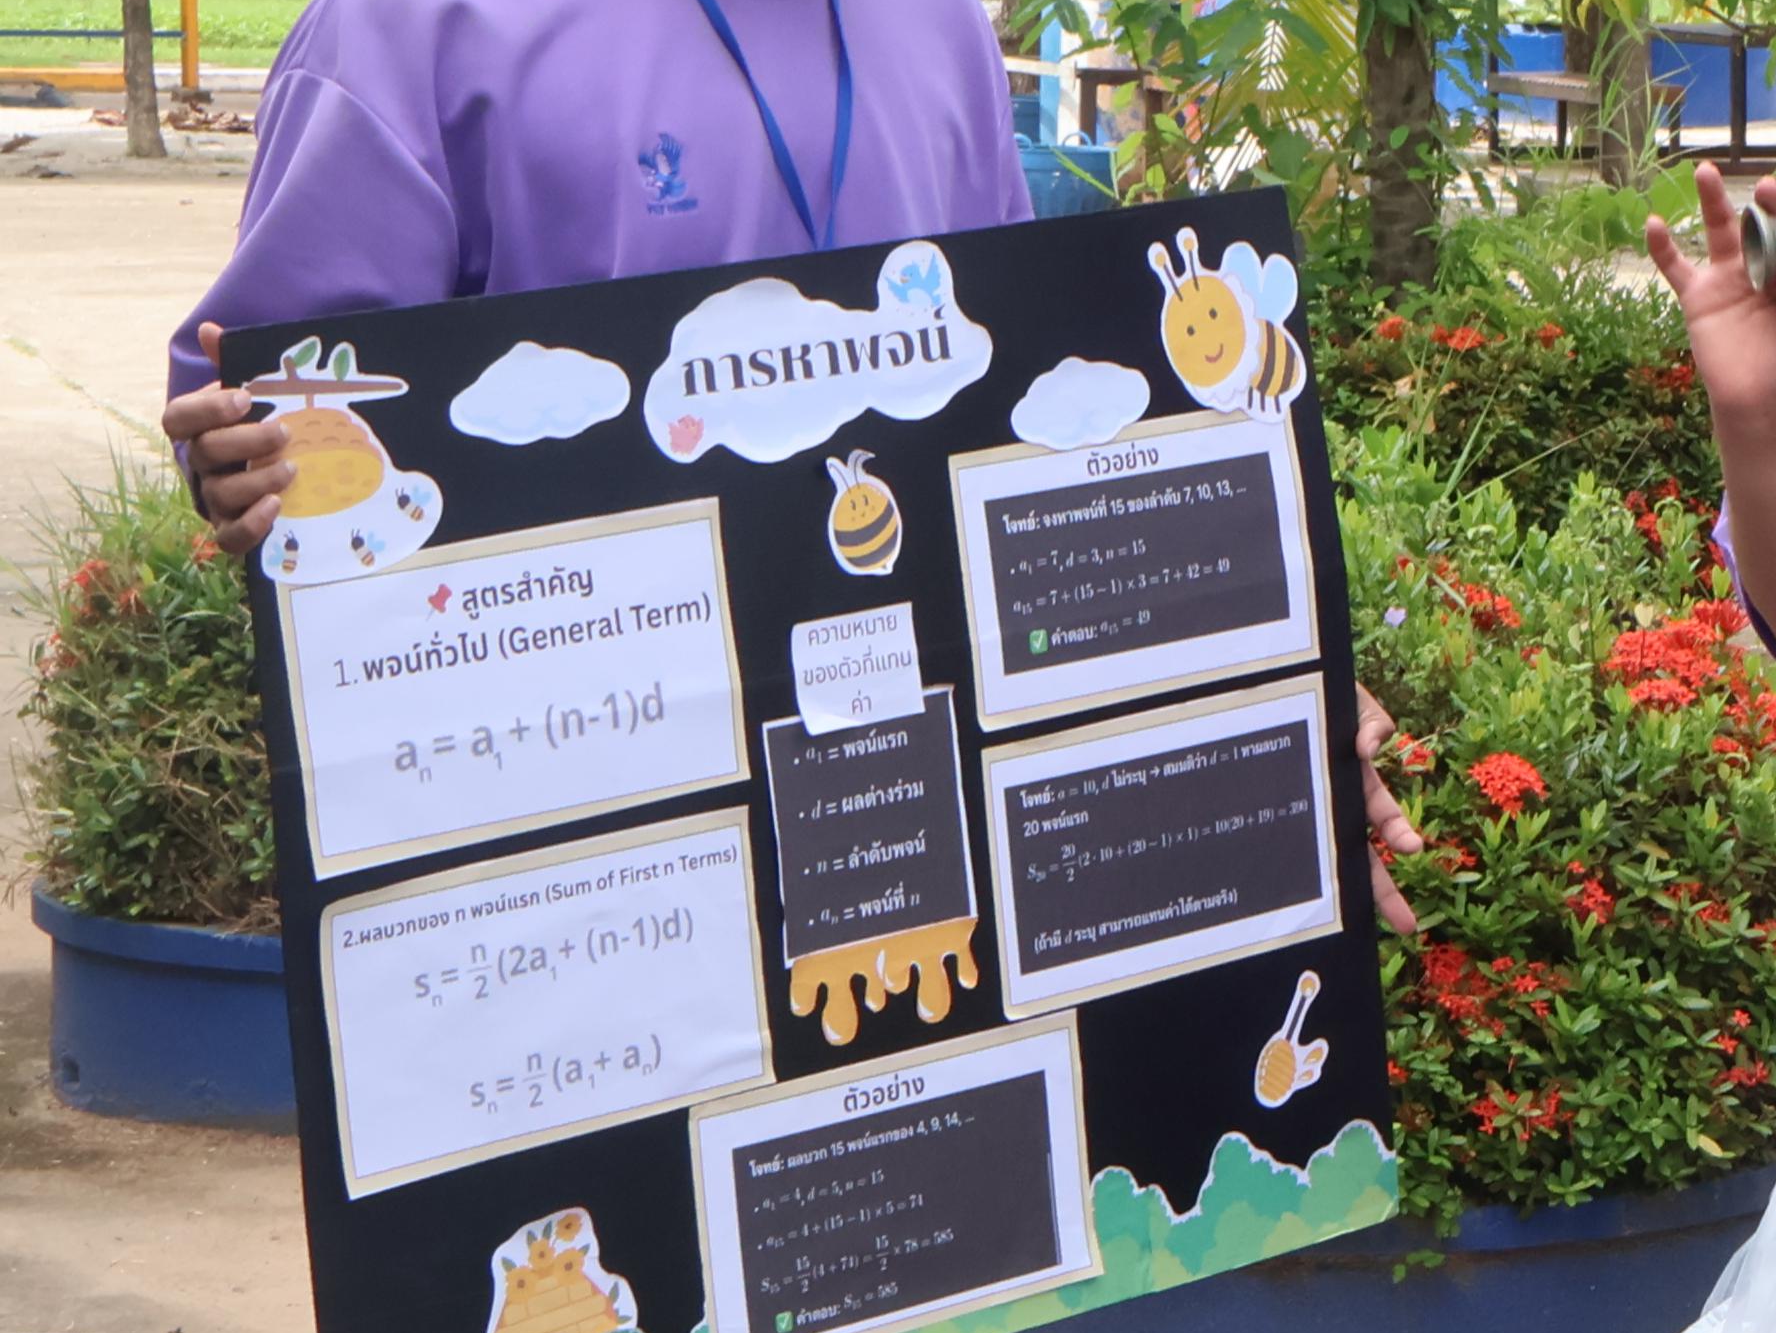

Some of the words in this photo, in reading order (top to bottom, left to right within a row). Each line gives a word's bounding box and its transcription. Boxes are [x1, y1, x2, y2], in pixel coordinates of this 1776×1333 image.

[682, 305, 952, 396] การหาพจน์
[1087, 443, 1158, 476] ตัวอย่าง
[1003, 510, 1041, 534] โจทย์:
[1043, 494, 1107, 528] จงหาพจน์ที่
[1110, 500, 1124, 515] 15
[1127, 490, 1180, 513] ของลำดับ
[1184, 487, 1194, 505] 7,
[1197, 484, 1214, 501] 10,
[1216, 480, 1233, 497] 13,
[1050, 550, 1063, 572] 7,
[1091, 548, 1103, 565] 3,
[1132, 539, 1146, 555] 15
[1185, 564, 1200, 579] 42
[1217, 558, 1230, 573] 49
[462, 566, 594, 620] สูตรสำคัญ
[363, 632, 488, 681] พจน์ทั่วไป
[499, 608, 622, 660] (General
[630, 592, 711, 630] Term)
[807, 614, 897, 647] ความหมาย
[1051, 626, 1098, 647] คำตอบ:
[1138, 610, 1150, 625] 49
[803, 646, 912, 686] ของตัวที่แทน
[433, 734, 456, 757] =
[509, 717, 530, 743] +
[545, 682, 665, 749] (n-1)d
[851, 693, 872, 715] ค่า
[843, 729, 908, 759] พจน์แรก
[811, 800, 821, 820] d
[842, 779, 924, 813] ผลต่างร่วม
[1020, 789, 1055, 809] โจทย์:
[1083, 780, 1099, 797] 10,
[1023, 821, 1039, 837] 20
[1041, 810, 1089, 833] พจน์แรก
[817, 859, 828, 873] n
[848, 829, 926, 869] ลำดับพจน์
[343, 911, 449, 948] 2.ผลบวกของ
[471, 891, 540, 918] พจน์แรก
[545, 880, 591, 905] (Sum
[596, 870, 615, 891] of
[620, 864, 659, 887] First
[664, 861, 675, 876] n
[678, 844, 738, 873] Terms)
[859, 882, 905, 917] พจน์ที่
[587, 907, 694, 964] (n-1)d)
[843, 1073, 925, 1112] ตัวอย่าง
[830, 1141, 845, 1157] 15
[916, 1120, 928, 1136] 4,
[931, 1117, 942, 1132] 9,
[945, 1112, 962, 1127] 14,
[871, 1169, 885, 1185] 15
[796, 1303, 841, 1326] คำตอบ:
